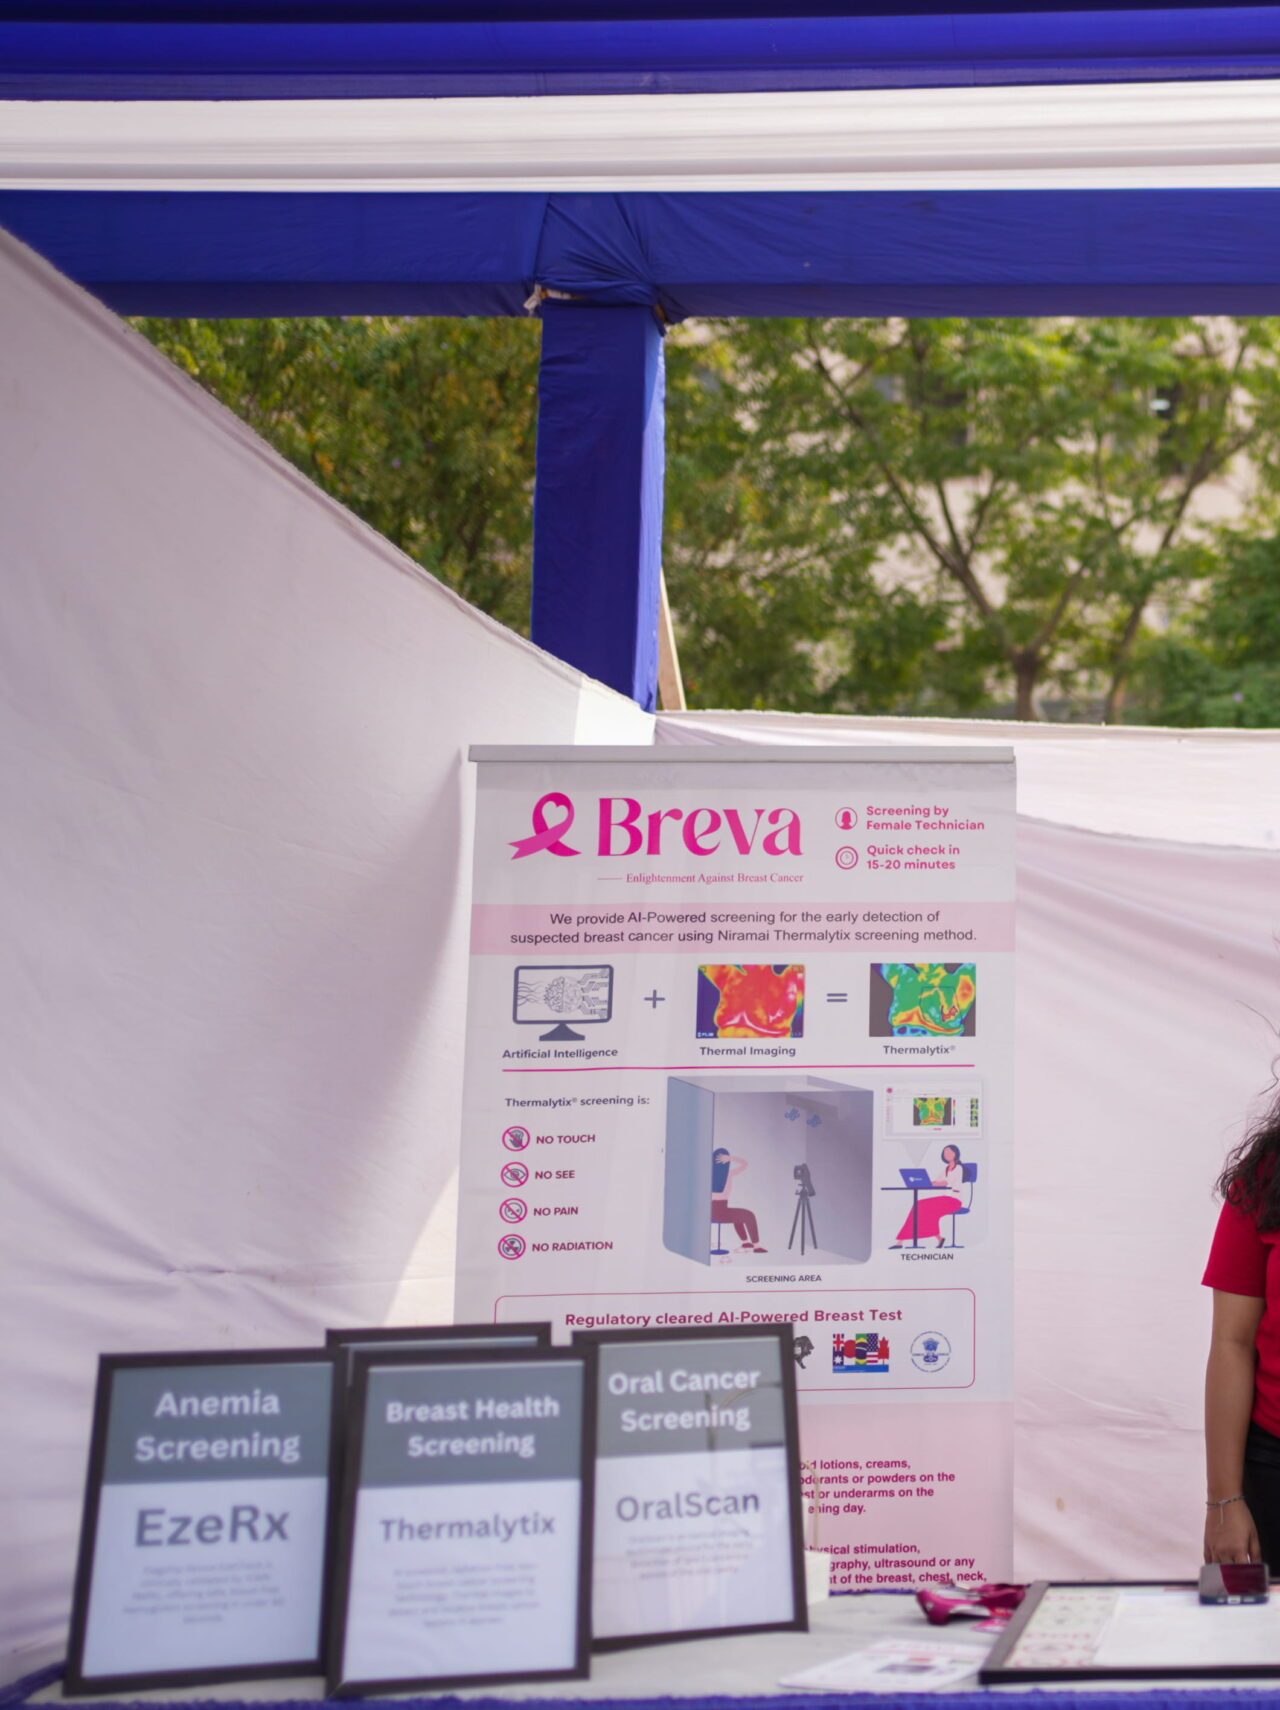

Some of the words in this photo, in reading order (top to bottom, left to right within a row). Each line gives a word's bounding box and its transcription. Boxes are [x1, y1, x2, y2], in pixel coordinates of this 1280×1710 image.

[866, 805, 929, 818] Screening
[934, 805, 949, 819] by
[597, 797, 803, 857] Breva
[866, 819, 912, 830] Female
[915, 819, 985, 831] Technician
[867, 845, 904, 857] Quick
[907, 845, 945, 856] check
[949, 845, 960, 855] in
[867, 859, 901, 870] 15-20
[904, 859, 955, 870] minutes
[626, 873, 696, 884] Enlightenment
[698, 873, 734, 884] Against
[737, 873, 767, 883] Breast
[770, 873, 803, 882] Cancer
[550, 912, 572, 924] We
[576, 911, 624, 927] provide
[628, 911, 706, 923] AI-Powered
[710, 911, 775, 926] screening
[779, 911, 797, 923] for
[802, 911, 823, 923] the
[826, 911, 859, 925] early
[863, 910, 922, 923] detection
[926, 910, 940, 922] of
[510, 930, 579, 946] suspected
[584, 930, 625, 943] breast
[629, 931, 673, 942] cancer
[678, 929, 714, 945] using
[718, 929, 769, 941] Niramai
[774, 928, 850, 944] Thermalytix
[855, 928, 919, 943] screening
[924, 928, 977, 941] method.
[502, 1047, 551, 1060] Artificial
[554, 1046, 618, 1059] Intelligence
[700, 1045, 748, 1056] Thermal
[750, 1045, 796, 1058] Imaging
[581, 1095, 634, 1108] screening
[637, 1095, 650, 1105] is:
[536, 1133, 554, 1144] NO
[557, 1133, 595, 1144] TOUCH
[535, 1170, 553, 1180] NO
[555, 1169, 575, 1179] SEE
[533, 1206, 552, 1216] NO
[554, 1205, 578, 1216] PAIN
[532, 1241, 550, 1252] NO
[553, 1240, 613, 1251] RADIATION
[900, 1252, 954, 1261] TECHNICIAN
[745, 1274, 797, 1284] SCREENING
[799, 1273, 822, 1283] AREA
[565, 1312, 651, 1329] Regulatory
[655, 1311, 713, 1325] cleared
[718, 1309, 809, 1324] AI-Powered
[814, 1308, 864, 1322] Breast
[869, 1308, 902, 1322] Test
[608, 1371, 664, 1395] Oral
[670, 1369, 761, 1392] Cancer
[155, 1389, 280, 1417] Anemia
[386, 1401, 468, 1424] Breast
[475, 1396, 559, 1419] Health
[621, 1406, 750, 1431] Screening
[135, 1432, 301, 1464] Screening
[408, 1433, 536, 1458] Screening
[820, 1459, 862, 1470] lotions,
[866, 1460, 911, 1469] creams,
[852, 1475, 863, 1483] or
[868, 1473, 916, 1485] powders
[920, 1474, 934, 1482] on
[937, 1473, 955, 1482] the
[819, 1489, 830, 1498] or
[834, 1488, 894, 1498] underarms
[898, 1488, 913, 1496] on
[917, 1487, 934, 1496] the
[616, 1494, 760, 1522] OralScan
[844, 1503, 866, 1514] day.
[135, 1504, 289, 1548] EzeRx
[380, 1512, 555, 1542] Thermalytix
[854, 1543, 920, 1555] stimulation,
[831, 1560, 870, 1572] graphy,
[875, 1558, 936, 1568] ultrasound
[939, 1559, 951, 1567] or
[955, 1558, 975, 1568] any
[841, 1574, 851, 1583] of
[855, 1574, 872, 1583] the
[877, 1573, 915, 1584] breast,
[919, 1572, 952, 1583] chest,
[957, 1571, 986, 1582] neck,
